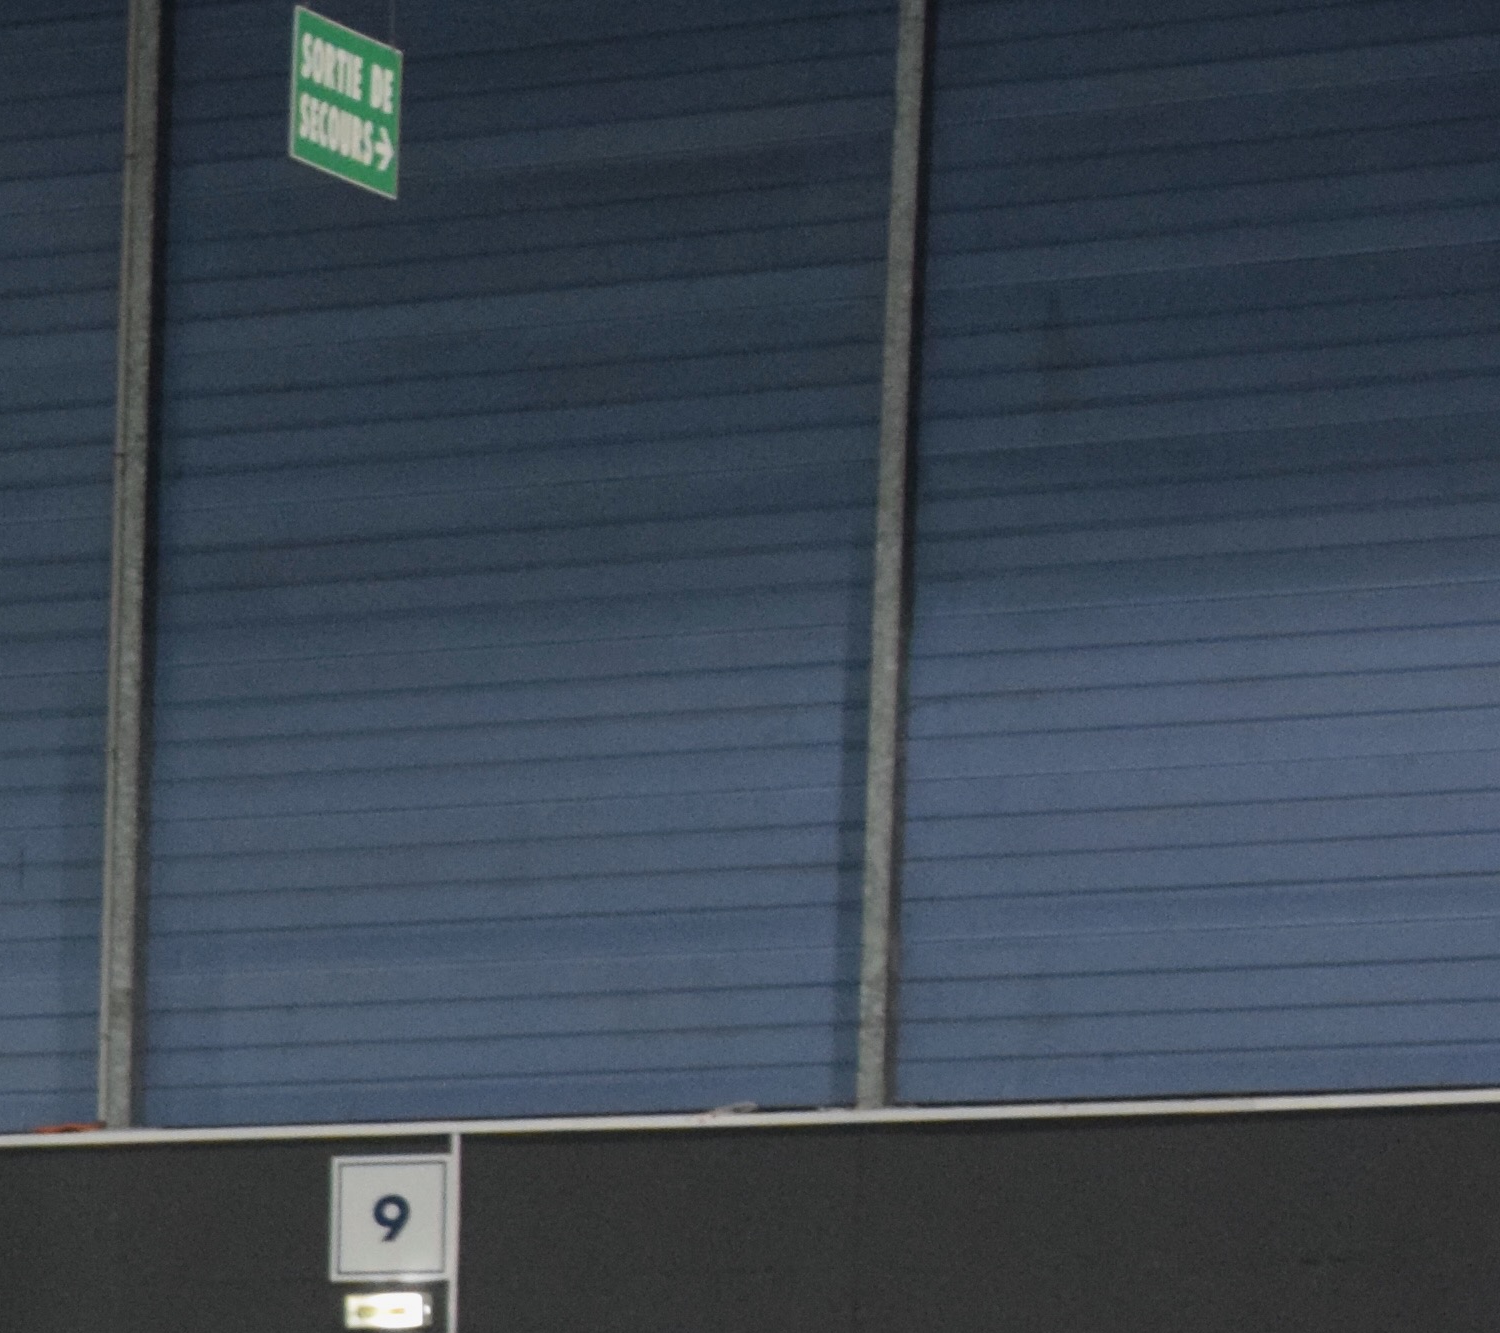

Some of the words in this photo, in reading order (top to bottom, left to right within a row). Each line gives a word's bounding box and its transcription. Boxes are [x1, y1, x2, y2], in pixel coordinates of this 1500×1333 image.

[301, 32, 363, 101] SORTIE
[370, 64, 394, 114] DE
[299, 93, 374, 165] SECOURS
[374, 1194, 411, 1242] 9
